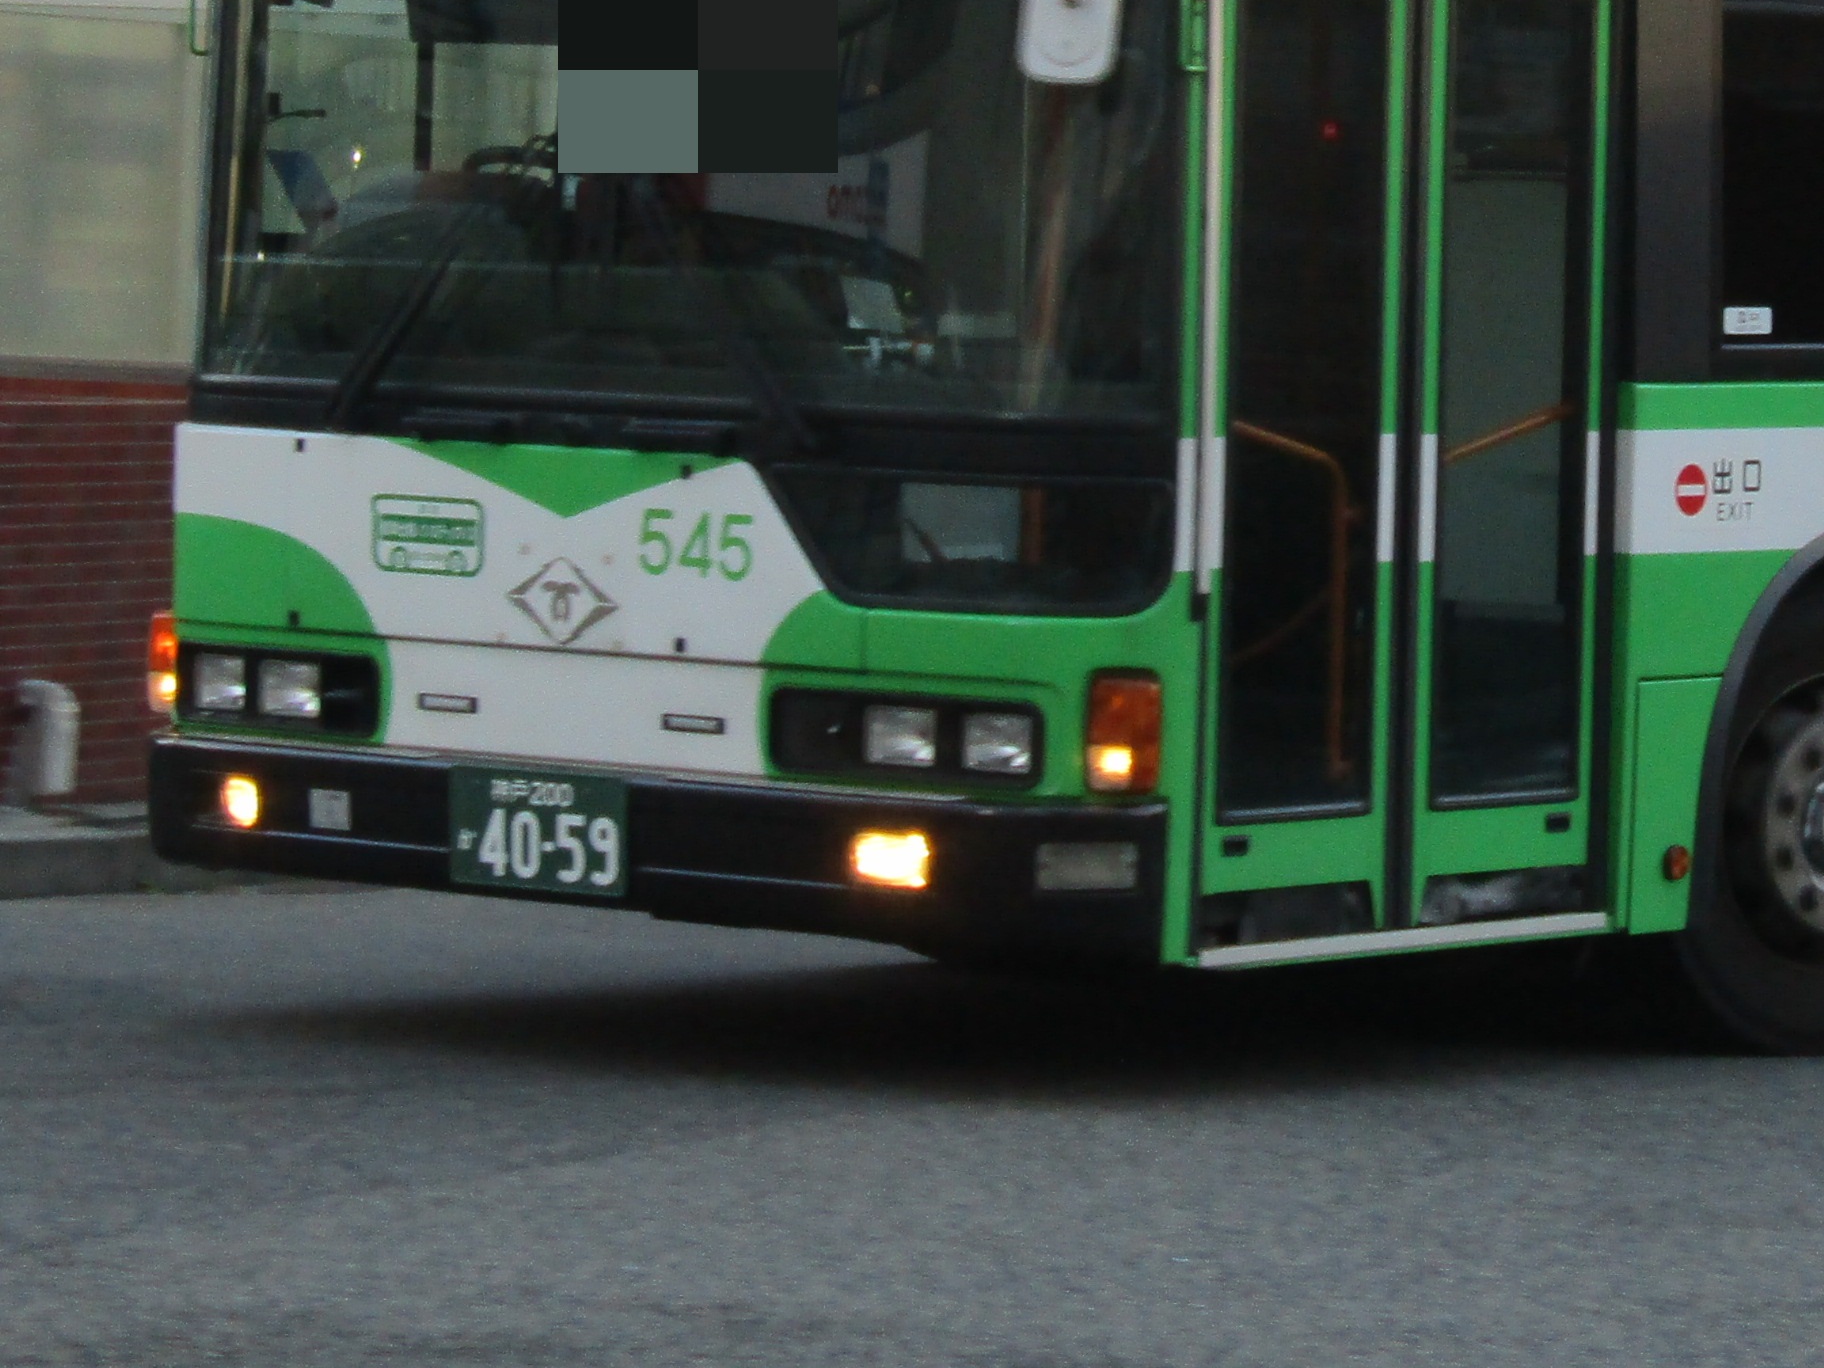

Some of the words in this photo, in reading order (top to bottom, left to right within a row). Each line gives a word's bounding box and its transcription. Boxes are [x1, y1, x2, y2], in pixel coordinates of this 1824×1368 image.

[1712, 459, 1762, 494] 出口
[1716, 501, 1754, 521] EXIT
[638, 508, 755, 582] 545
[478, 808, 620, 887] 40-59
